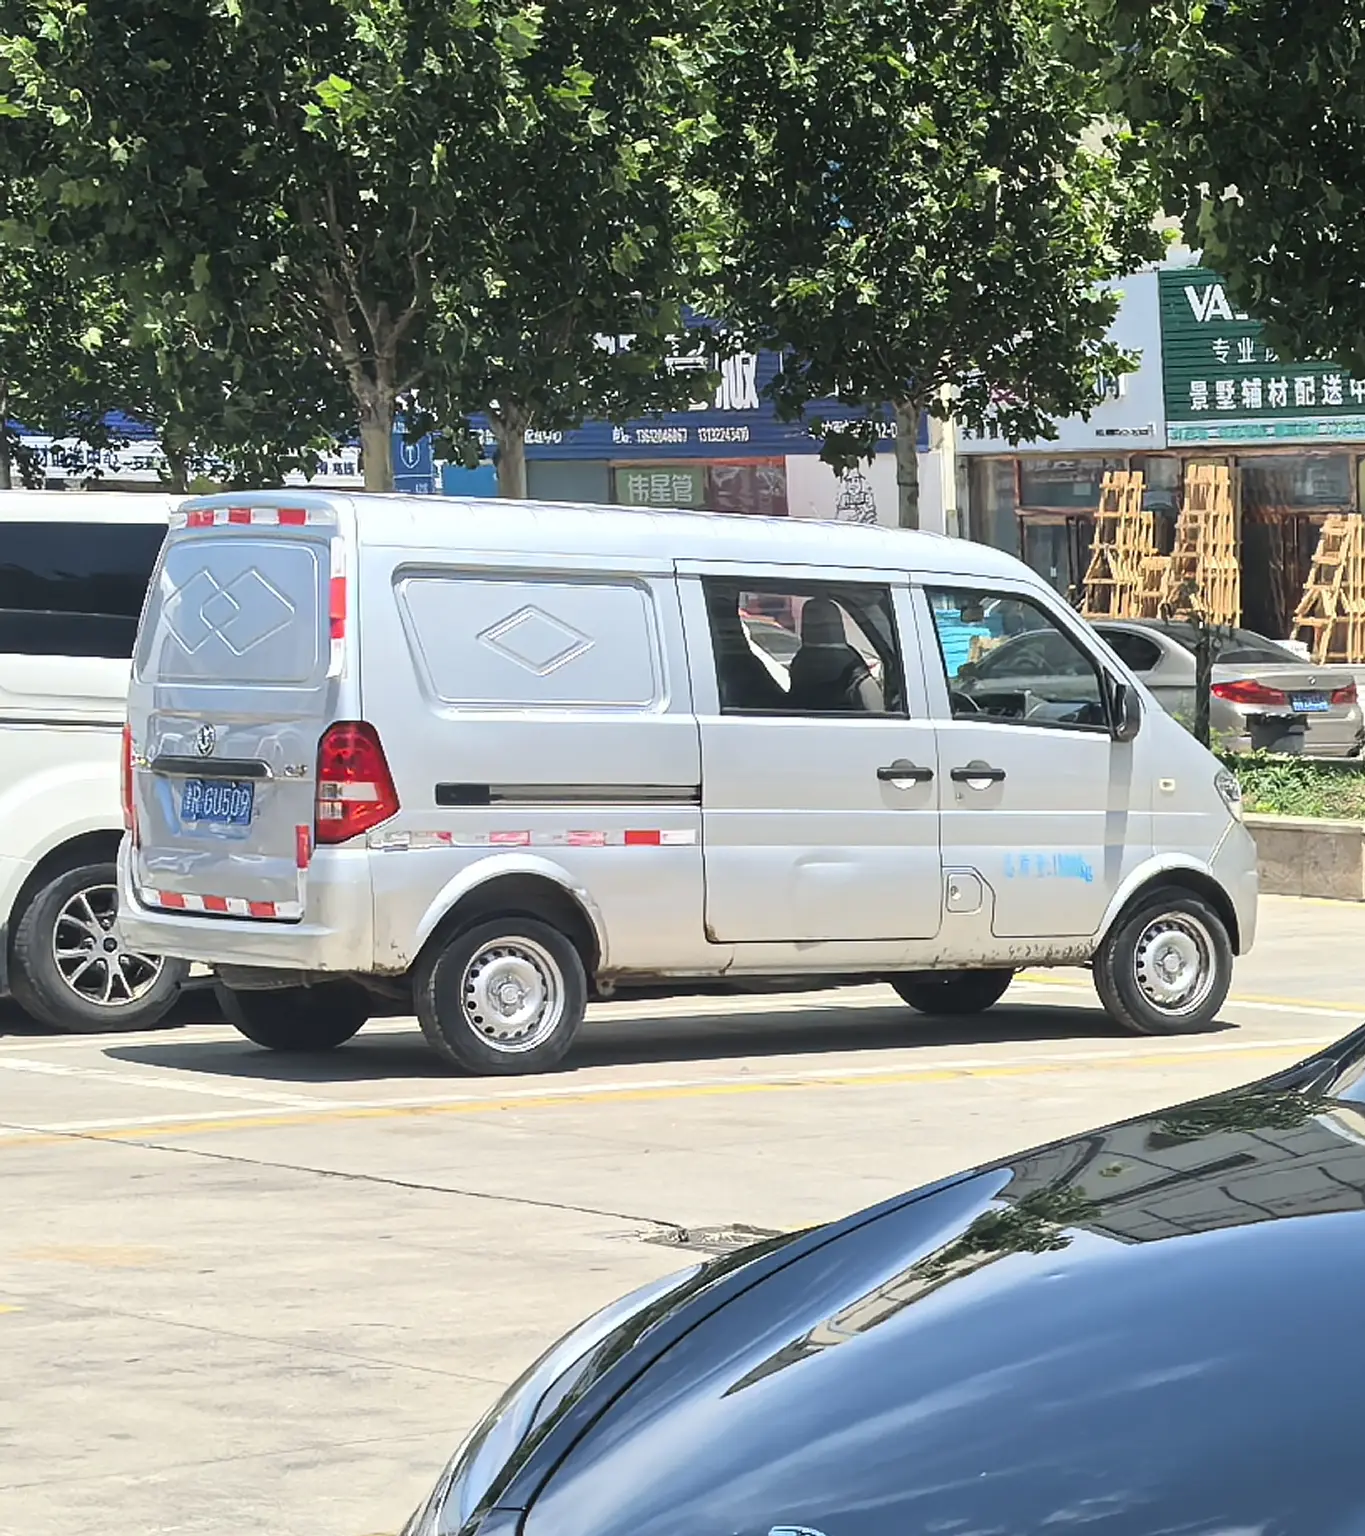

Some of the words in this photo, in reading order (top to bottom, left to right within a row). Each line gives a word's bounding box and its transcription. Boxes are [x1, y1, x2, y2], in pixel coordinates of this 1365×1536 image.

[1183, 283, 1249, 322] VA
[628, 474, 692, 503] 伟星管
